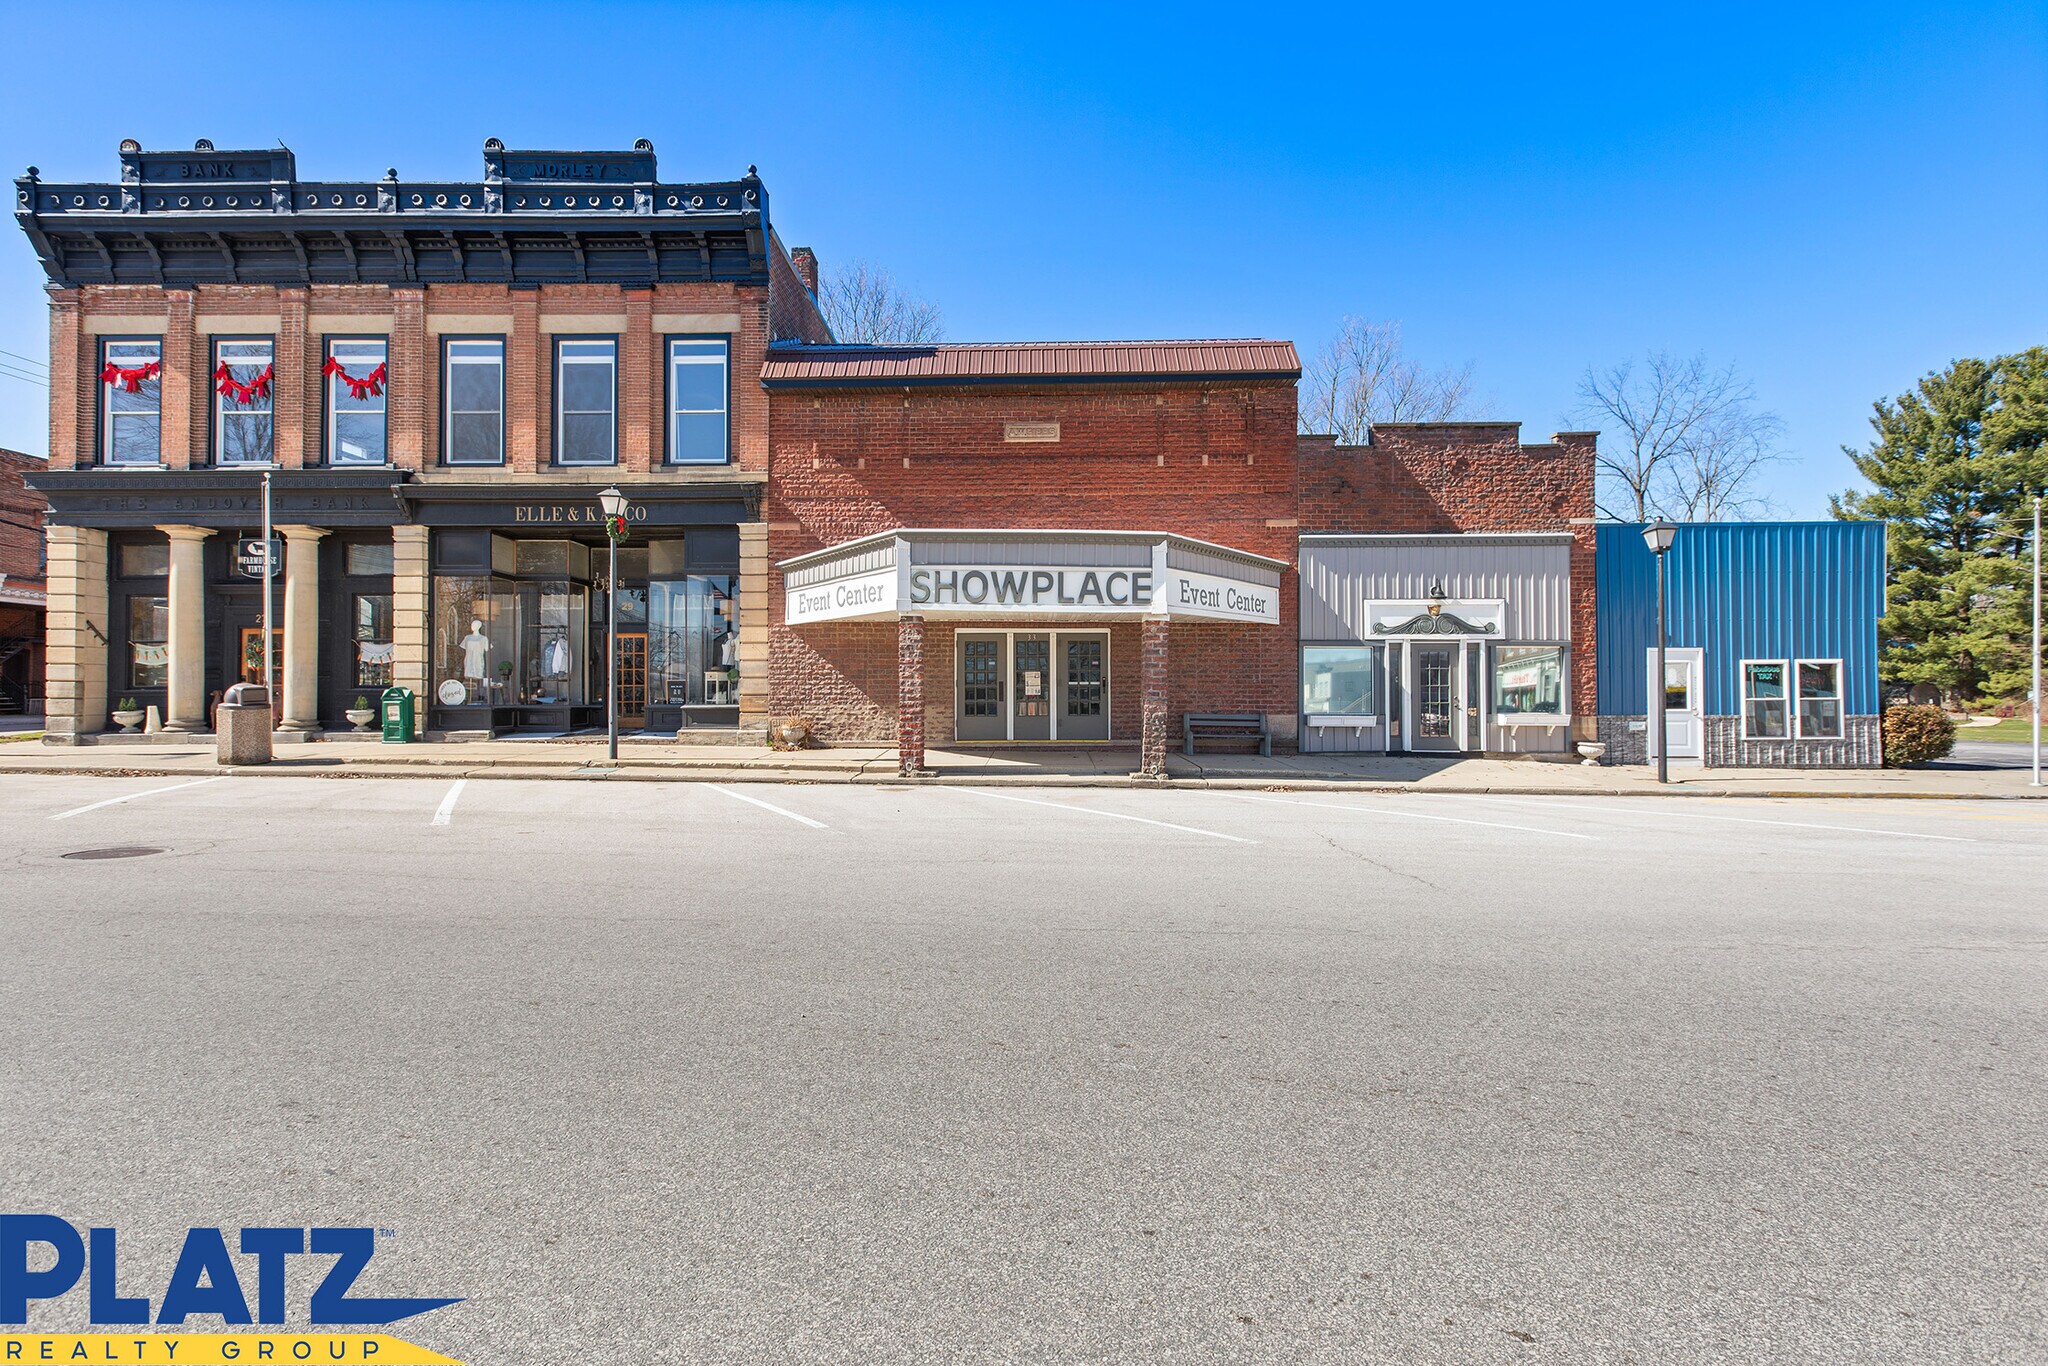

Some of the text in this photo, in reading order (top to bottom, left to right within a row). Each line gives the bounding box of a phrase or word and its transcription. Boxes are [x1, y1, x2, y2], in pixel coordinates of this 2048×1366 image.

[180, 162, 234, 178] BANK
[533, 163, 607, 178] MORLEY
[102, 497, 148, 510] THE
[312, 495, 369, 509] BANK
[515, 506, 563, 522] ELLE
[567, 506, 580, 522] &
[911, 569, 1153, 605] SHOWPLACE
[798, 584, 884, 614] Event Center
[1179, 579, 1267, 614] Event Center
[621, 602, 634, 611] 29
[1747, 664, 1781, 673] Fabulous
